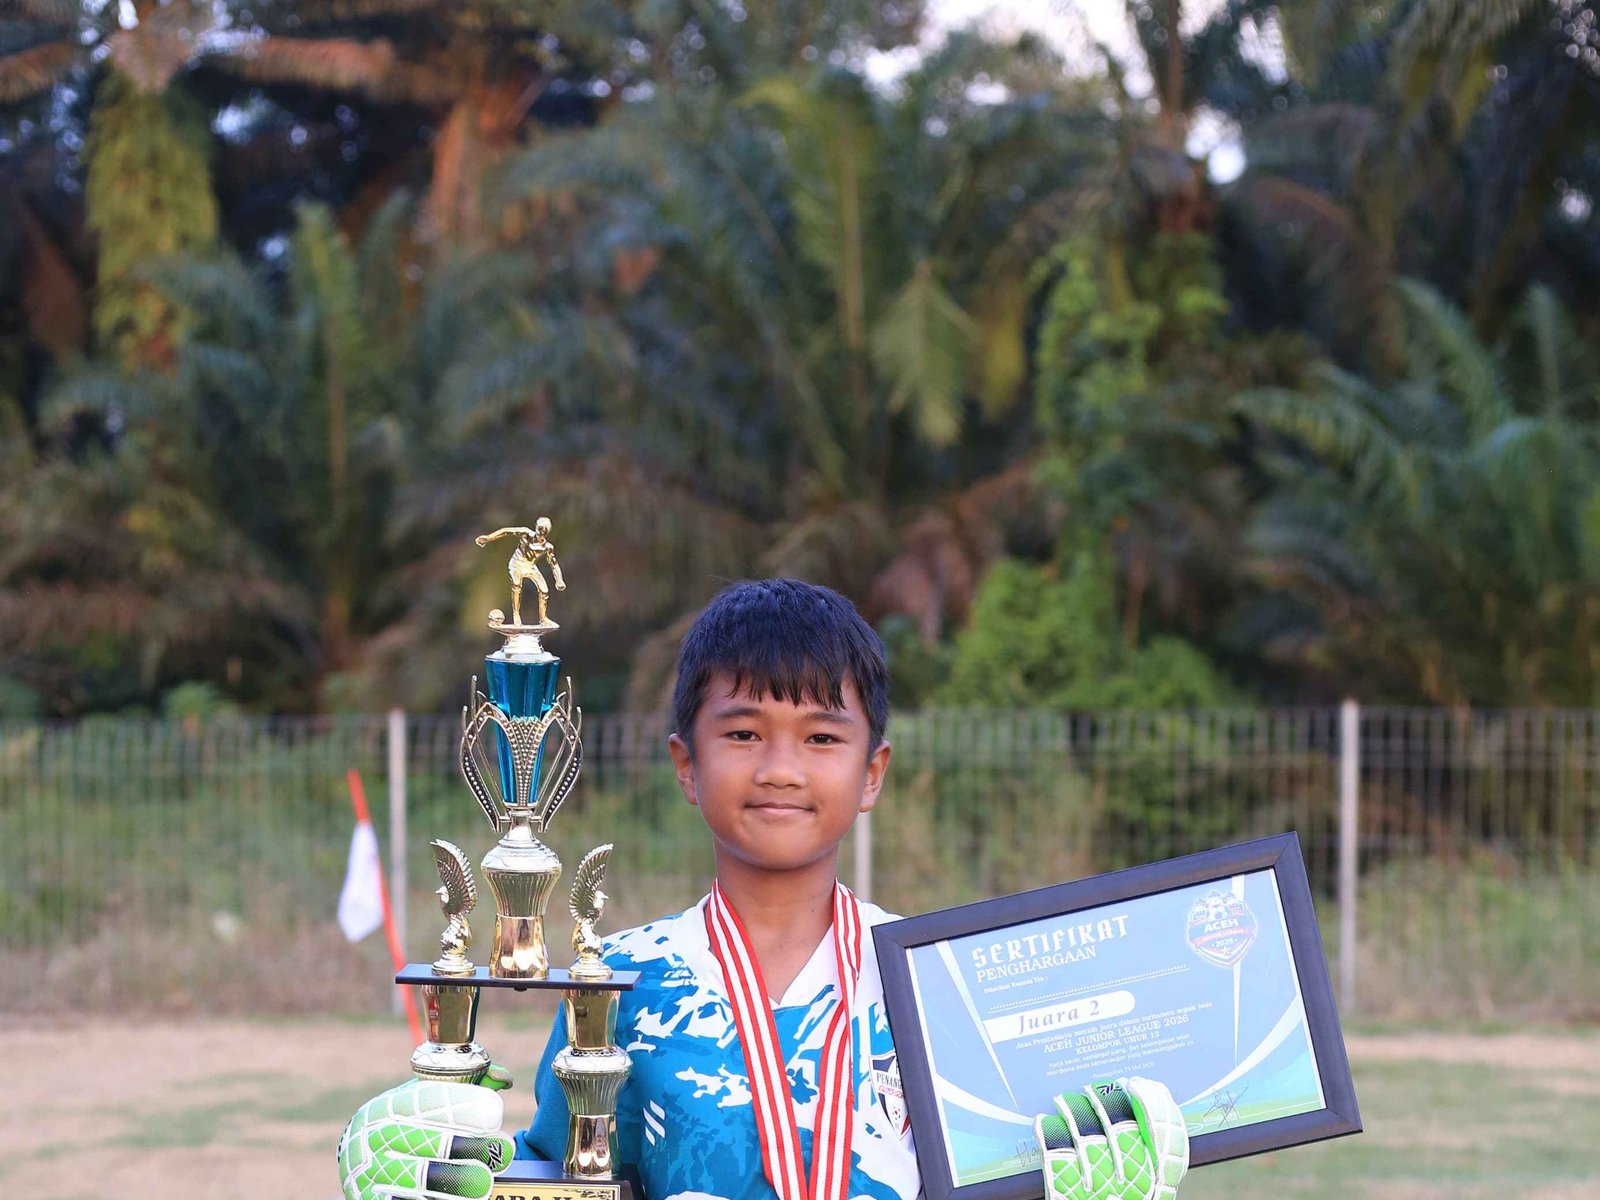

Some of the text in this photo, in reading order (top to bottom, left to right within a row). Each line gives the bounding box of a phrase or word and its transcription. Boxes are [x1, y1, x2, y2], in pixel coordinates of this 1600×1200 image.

[971, 914, 1129, 968] SERTIFIKAT
[1204, 918, 1239, 933] ACEH
[976, 945, 1097, 983] PENGHARGAAN
[1017, 1000, 1100, 1035] Juara 2
[1043, 1014, 1190, 1053] ACEH JUNIOR LEAGUE 2026
[1016, 1040, 1032, 1049] Atas
[1076, 1030, 1160, 1055] KELOMPOK UMUR 12
